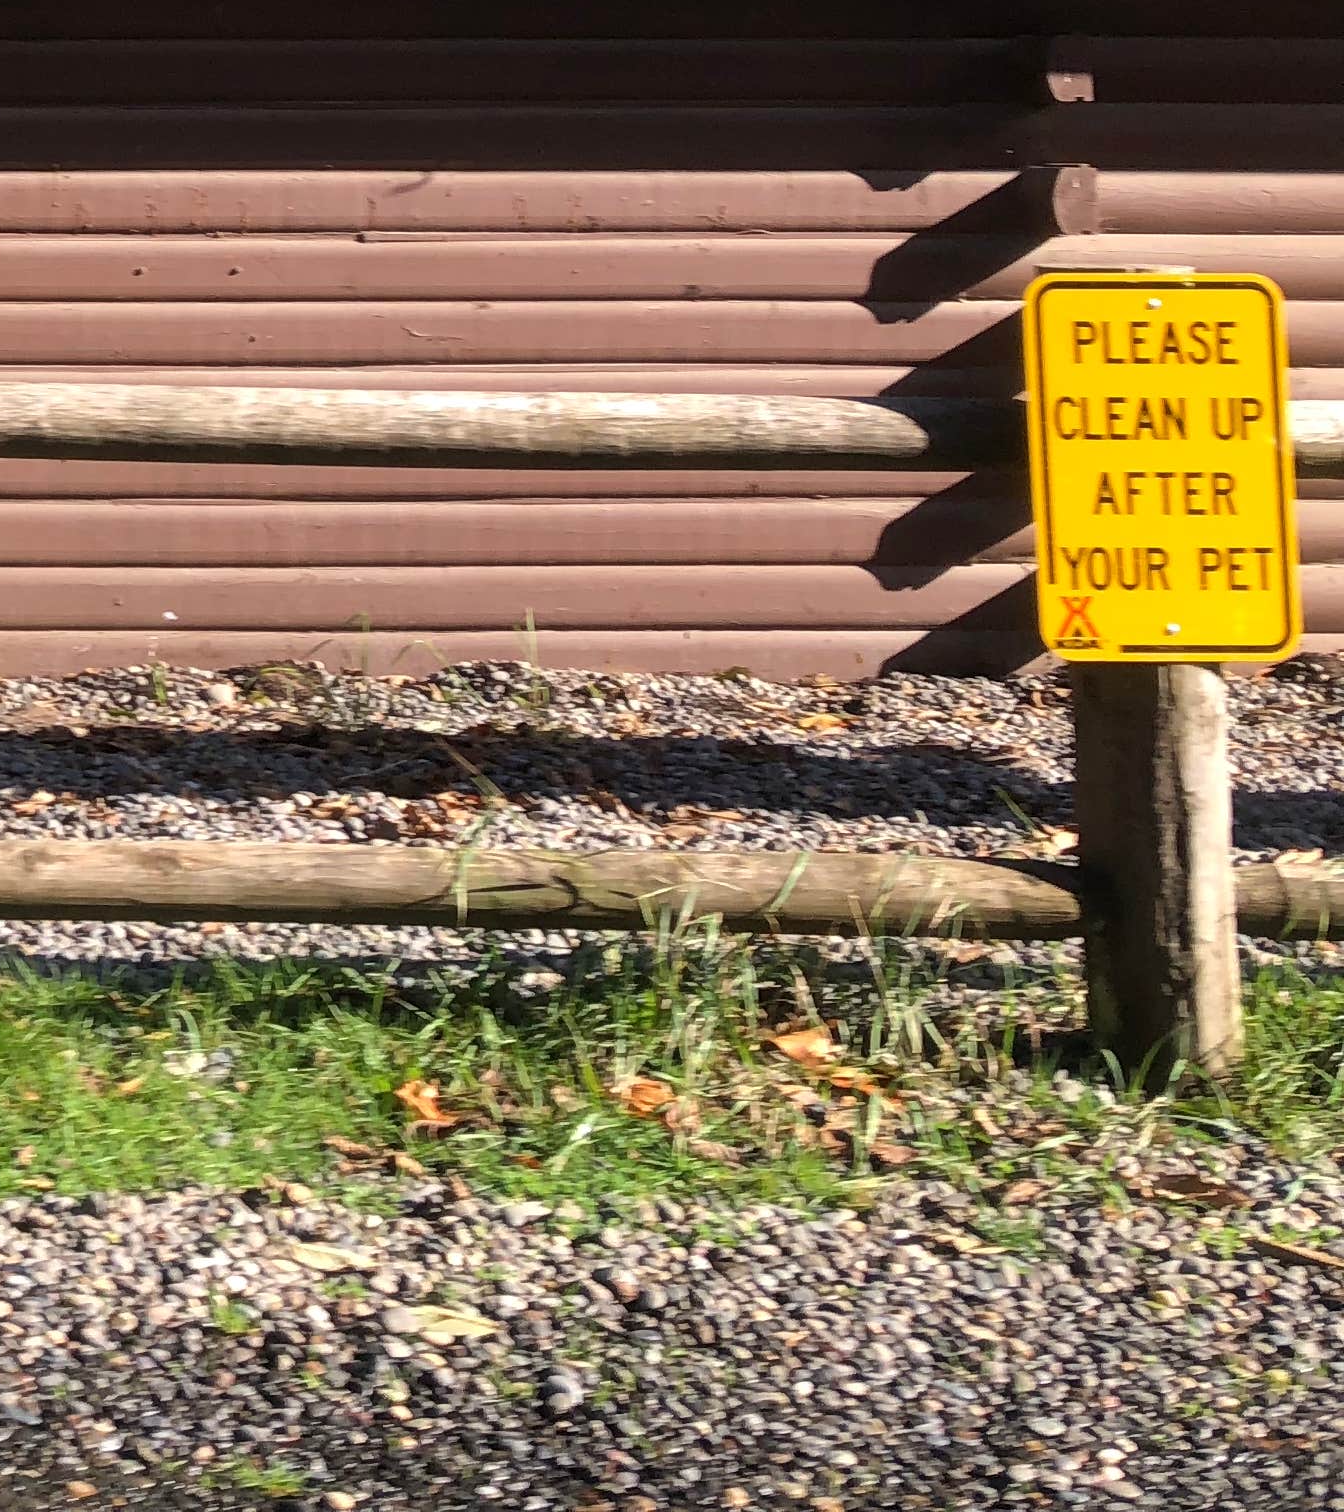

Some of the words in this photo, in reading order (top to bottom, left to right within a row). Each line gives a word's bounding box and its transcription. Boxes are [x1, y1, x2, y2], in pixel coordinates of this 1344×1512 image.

[1072, 320, 1240, 365] PLEASE
[1054, 396, 1189, 441] CLEAN
[1211, 397, 1263, 441] UP
[1093, 471, 1239, 516] AFTER
[1060, 546, 1171, 591] YOUR
[1200, 547, 1274, 591] PET
